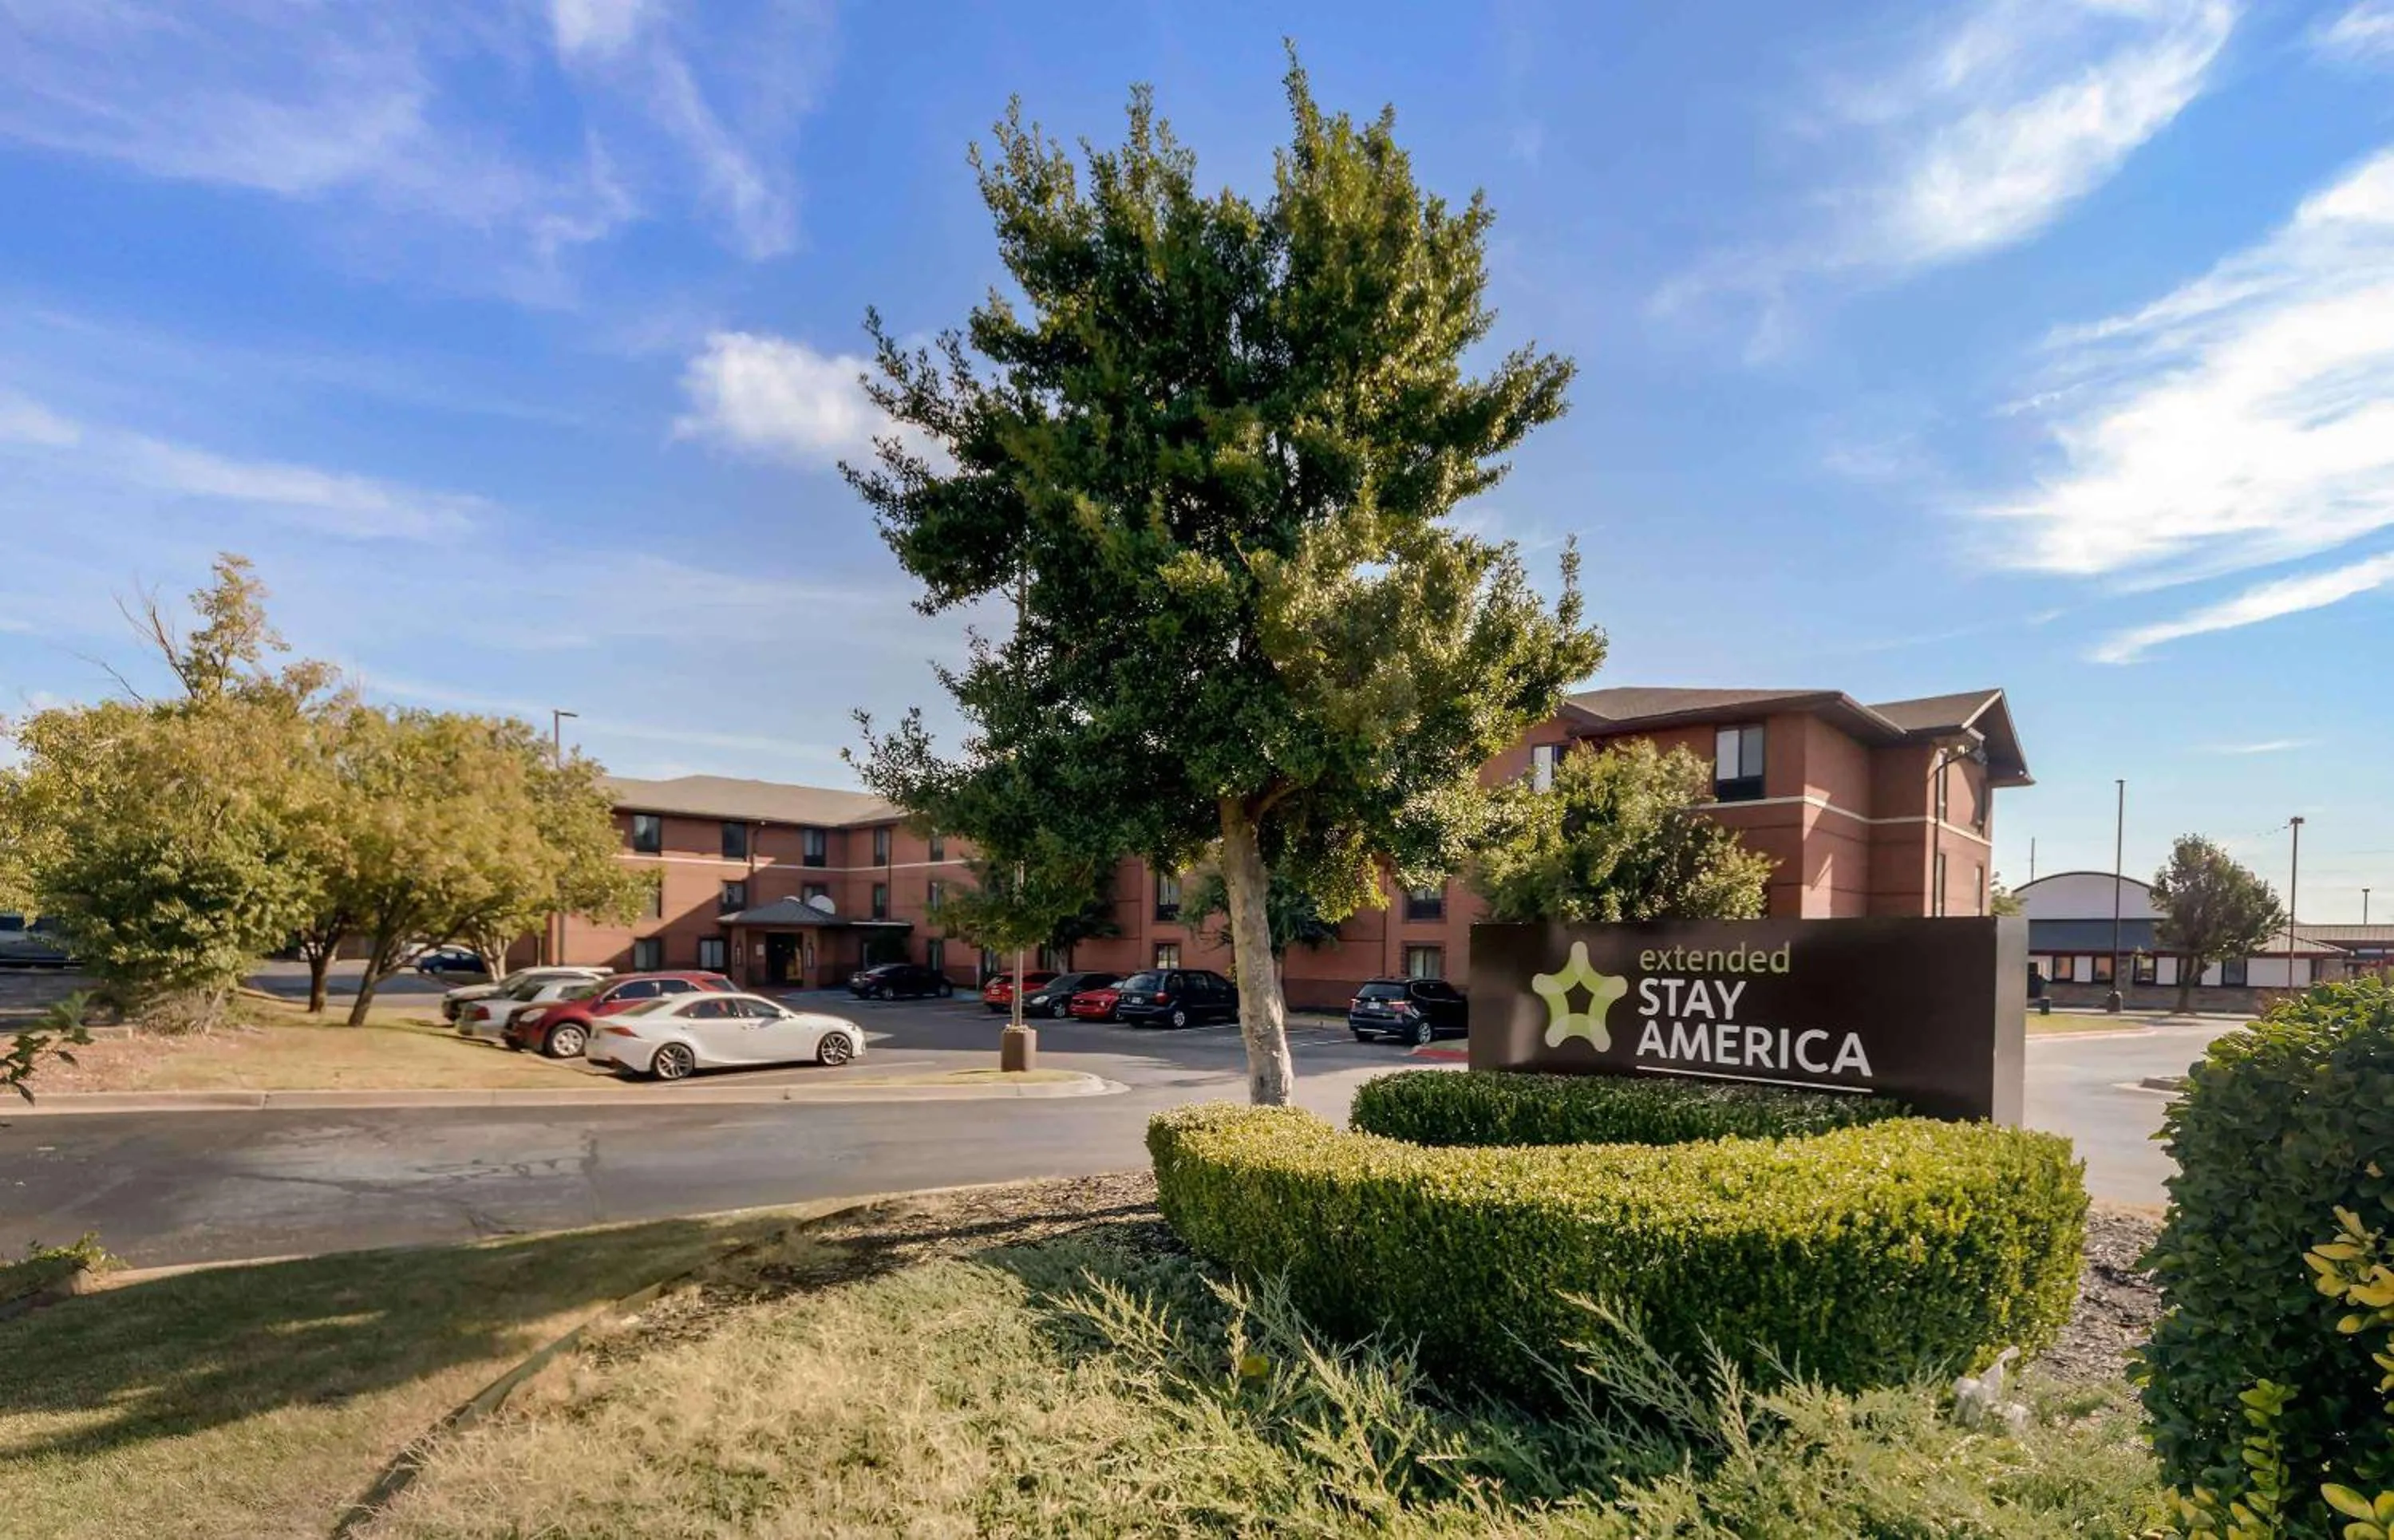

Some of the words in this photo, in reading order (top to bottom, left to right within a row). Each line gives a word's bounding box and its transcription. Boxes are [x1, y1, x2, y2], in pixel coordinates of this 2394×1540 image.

[1639, 942, 1791, 973] extended
[1637, 978, 1746, 1020] STAY
[1636, 1021, 1873, 1077] AMERICA
